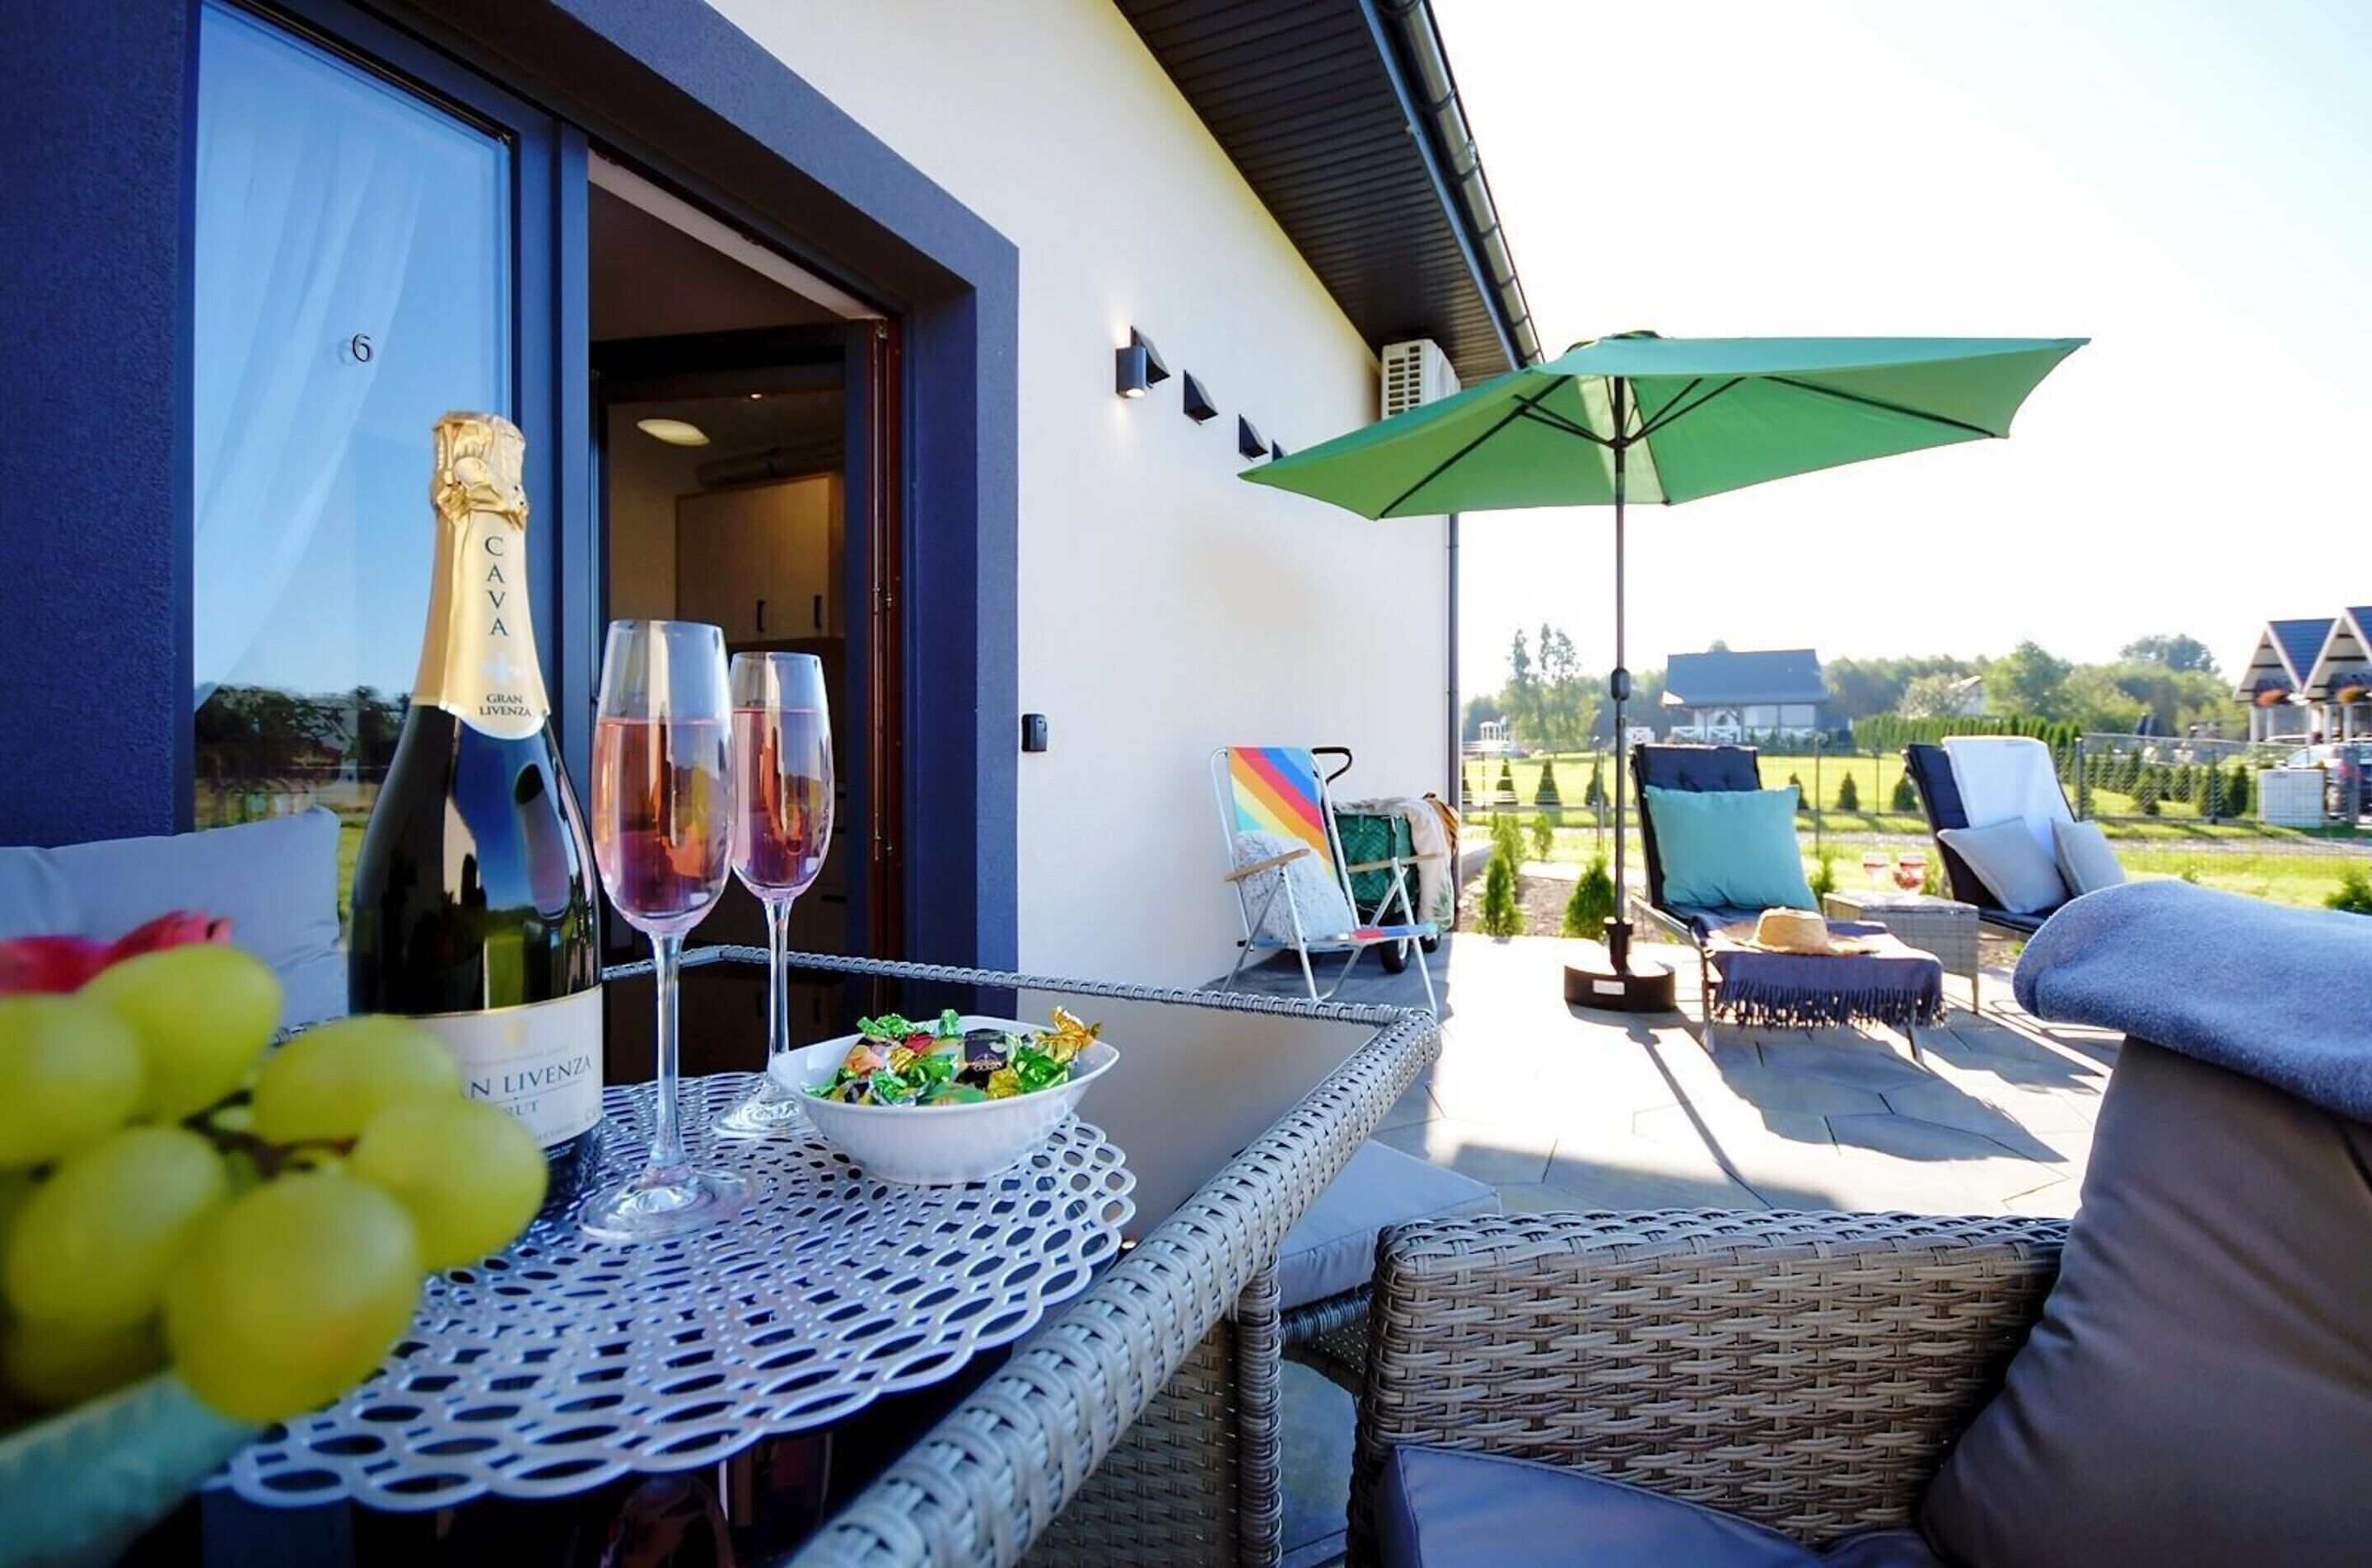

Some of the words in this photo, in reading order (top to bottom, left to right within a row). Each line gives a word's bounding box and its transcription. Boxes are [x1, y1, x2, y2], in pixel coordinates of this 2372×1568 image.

[353, 334, 371, 362] 6
[485, 536, 508, 636] CAVA
[479, 706, 531, 717] LIVENZA
[486, 693, 522, 704] GRAN
[504, 1055, 592, 1094] LIVENZA
